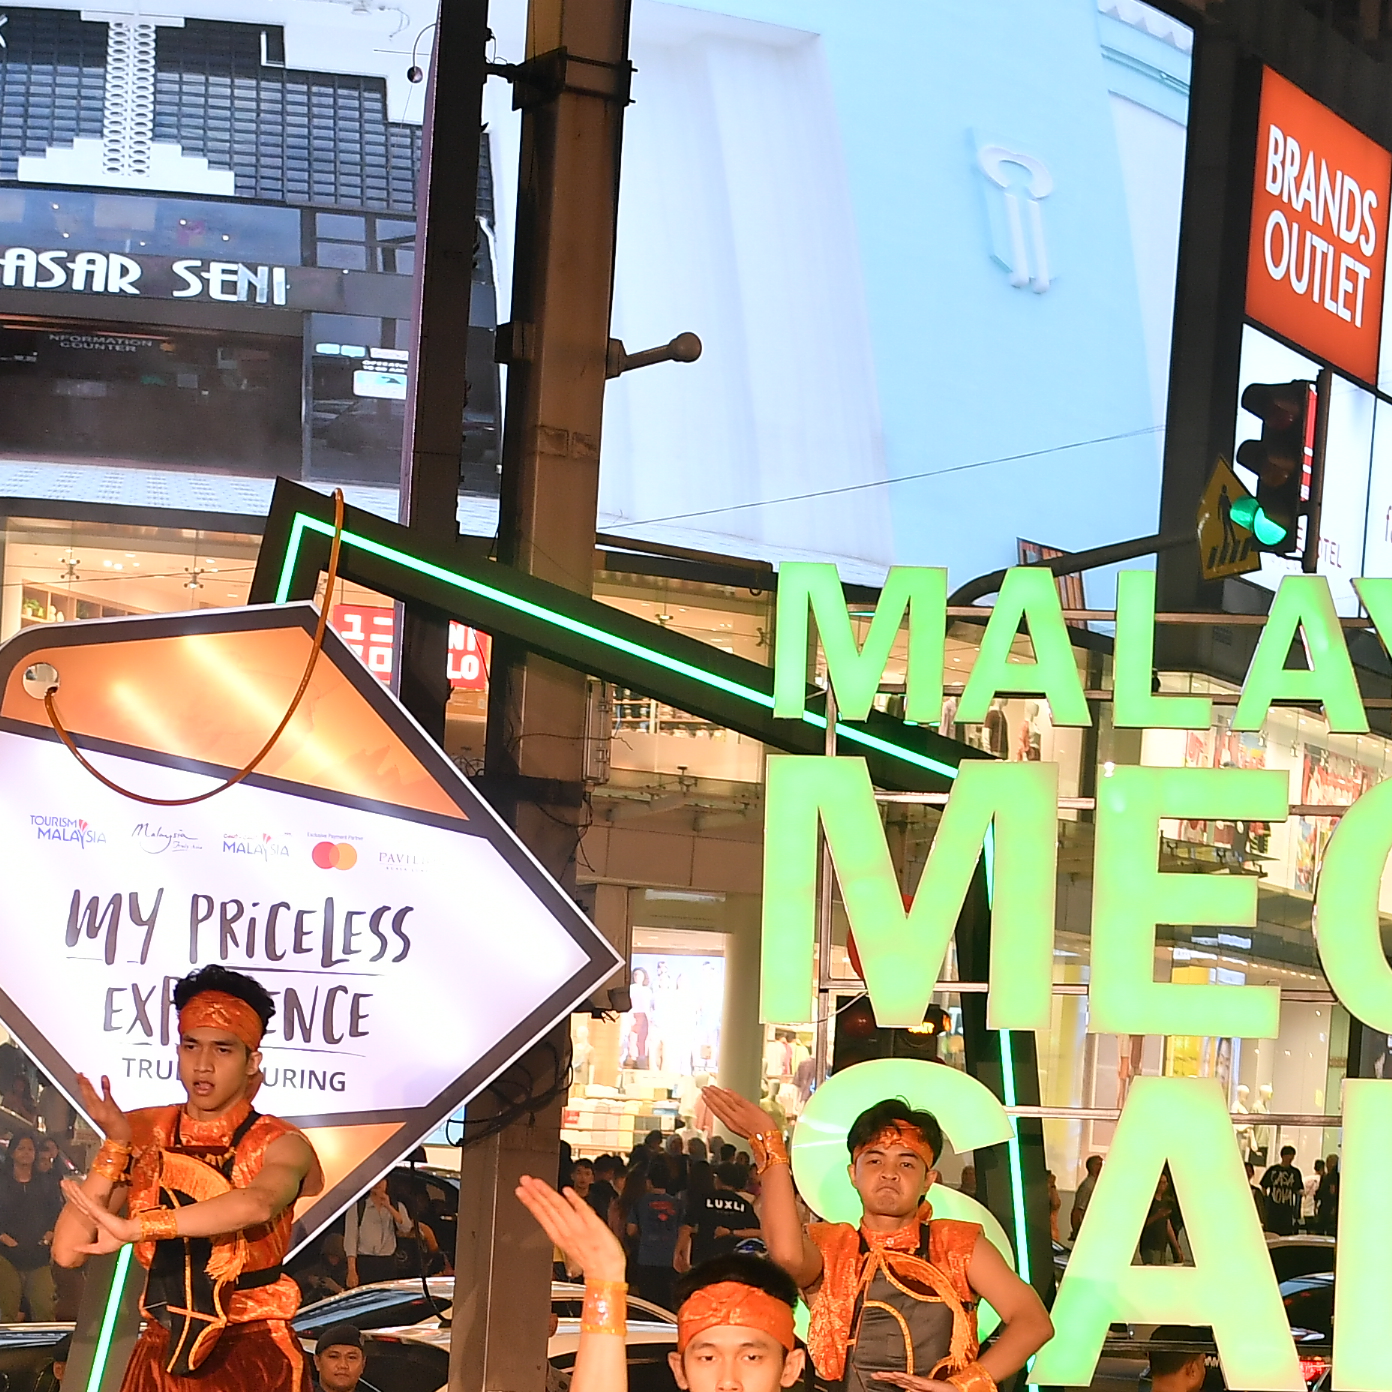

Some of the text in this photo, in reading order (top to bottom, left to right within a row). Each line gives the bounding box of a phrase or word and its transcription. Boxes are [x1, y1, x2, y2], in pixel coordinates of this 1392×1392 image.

[1265, 124, 1378, 257] BRANDS
[171, 259, 288, 306] SENI
[1264, 209, 1371, 329] OUTLET
[449, 622, 477, 651] NI
[446, 652, 479, 680] LO
[30, 815, 78, 828] TOURISM
[37, 826, 107, 850] MALAYSIA
[132, 822, 198, 855] Malaysia
[223, 840, 290, 862] MALAYSIA
[328, 833, 347, 841] Payment
[65, 888, 164, 965] MY
[104, 976, 374, 1046] EXPENCE
[706, 1198, 745, 1213] LUXLI
